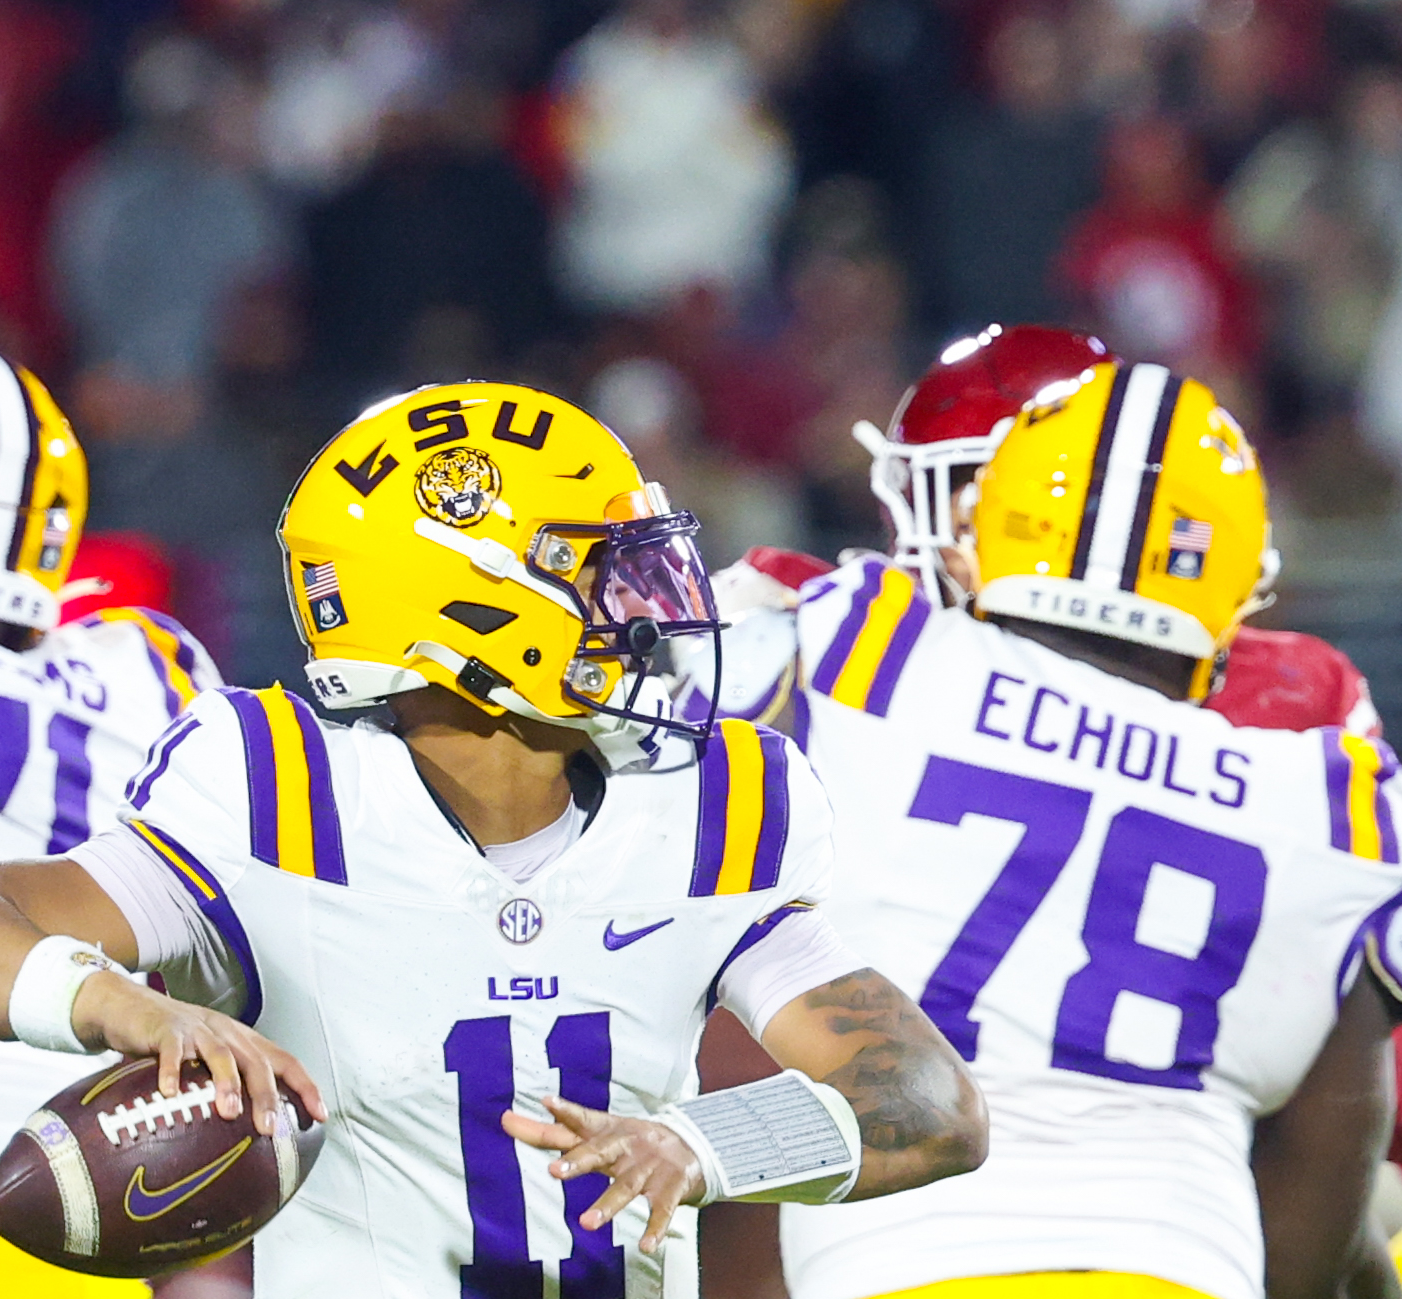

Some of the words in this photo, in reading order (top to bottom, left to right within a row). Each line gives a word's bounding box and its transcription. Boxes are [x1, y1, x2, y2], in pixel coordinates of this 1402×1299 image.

[334, 400, 554, 498] LSU
[1029, 591, 1173, 636] TIGERS
[975, 671, 1251, 808] ECHOLS
[500, 900, 541, 941] SEC
[907, 754, 1269, 1092] 78
[488, 976, 558, 1000] LSU
